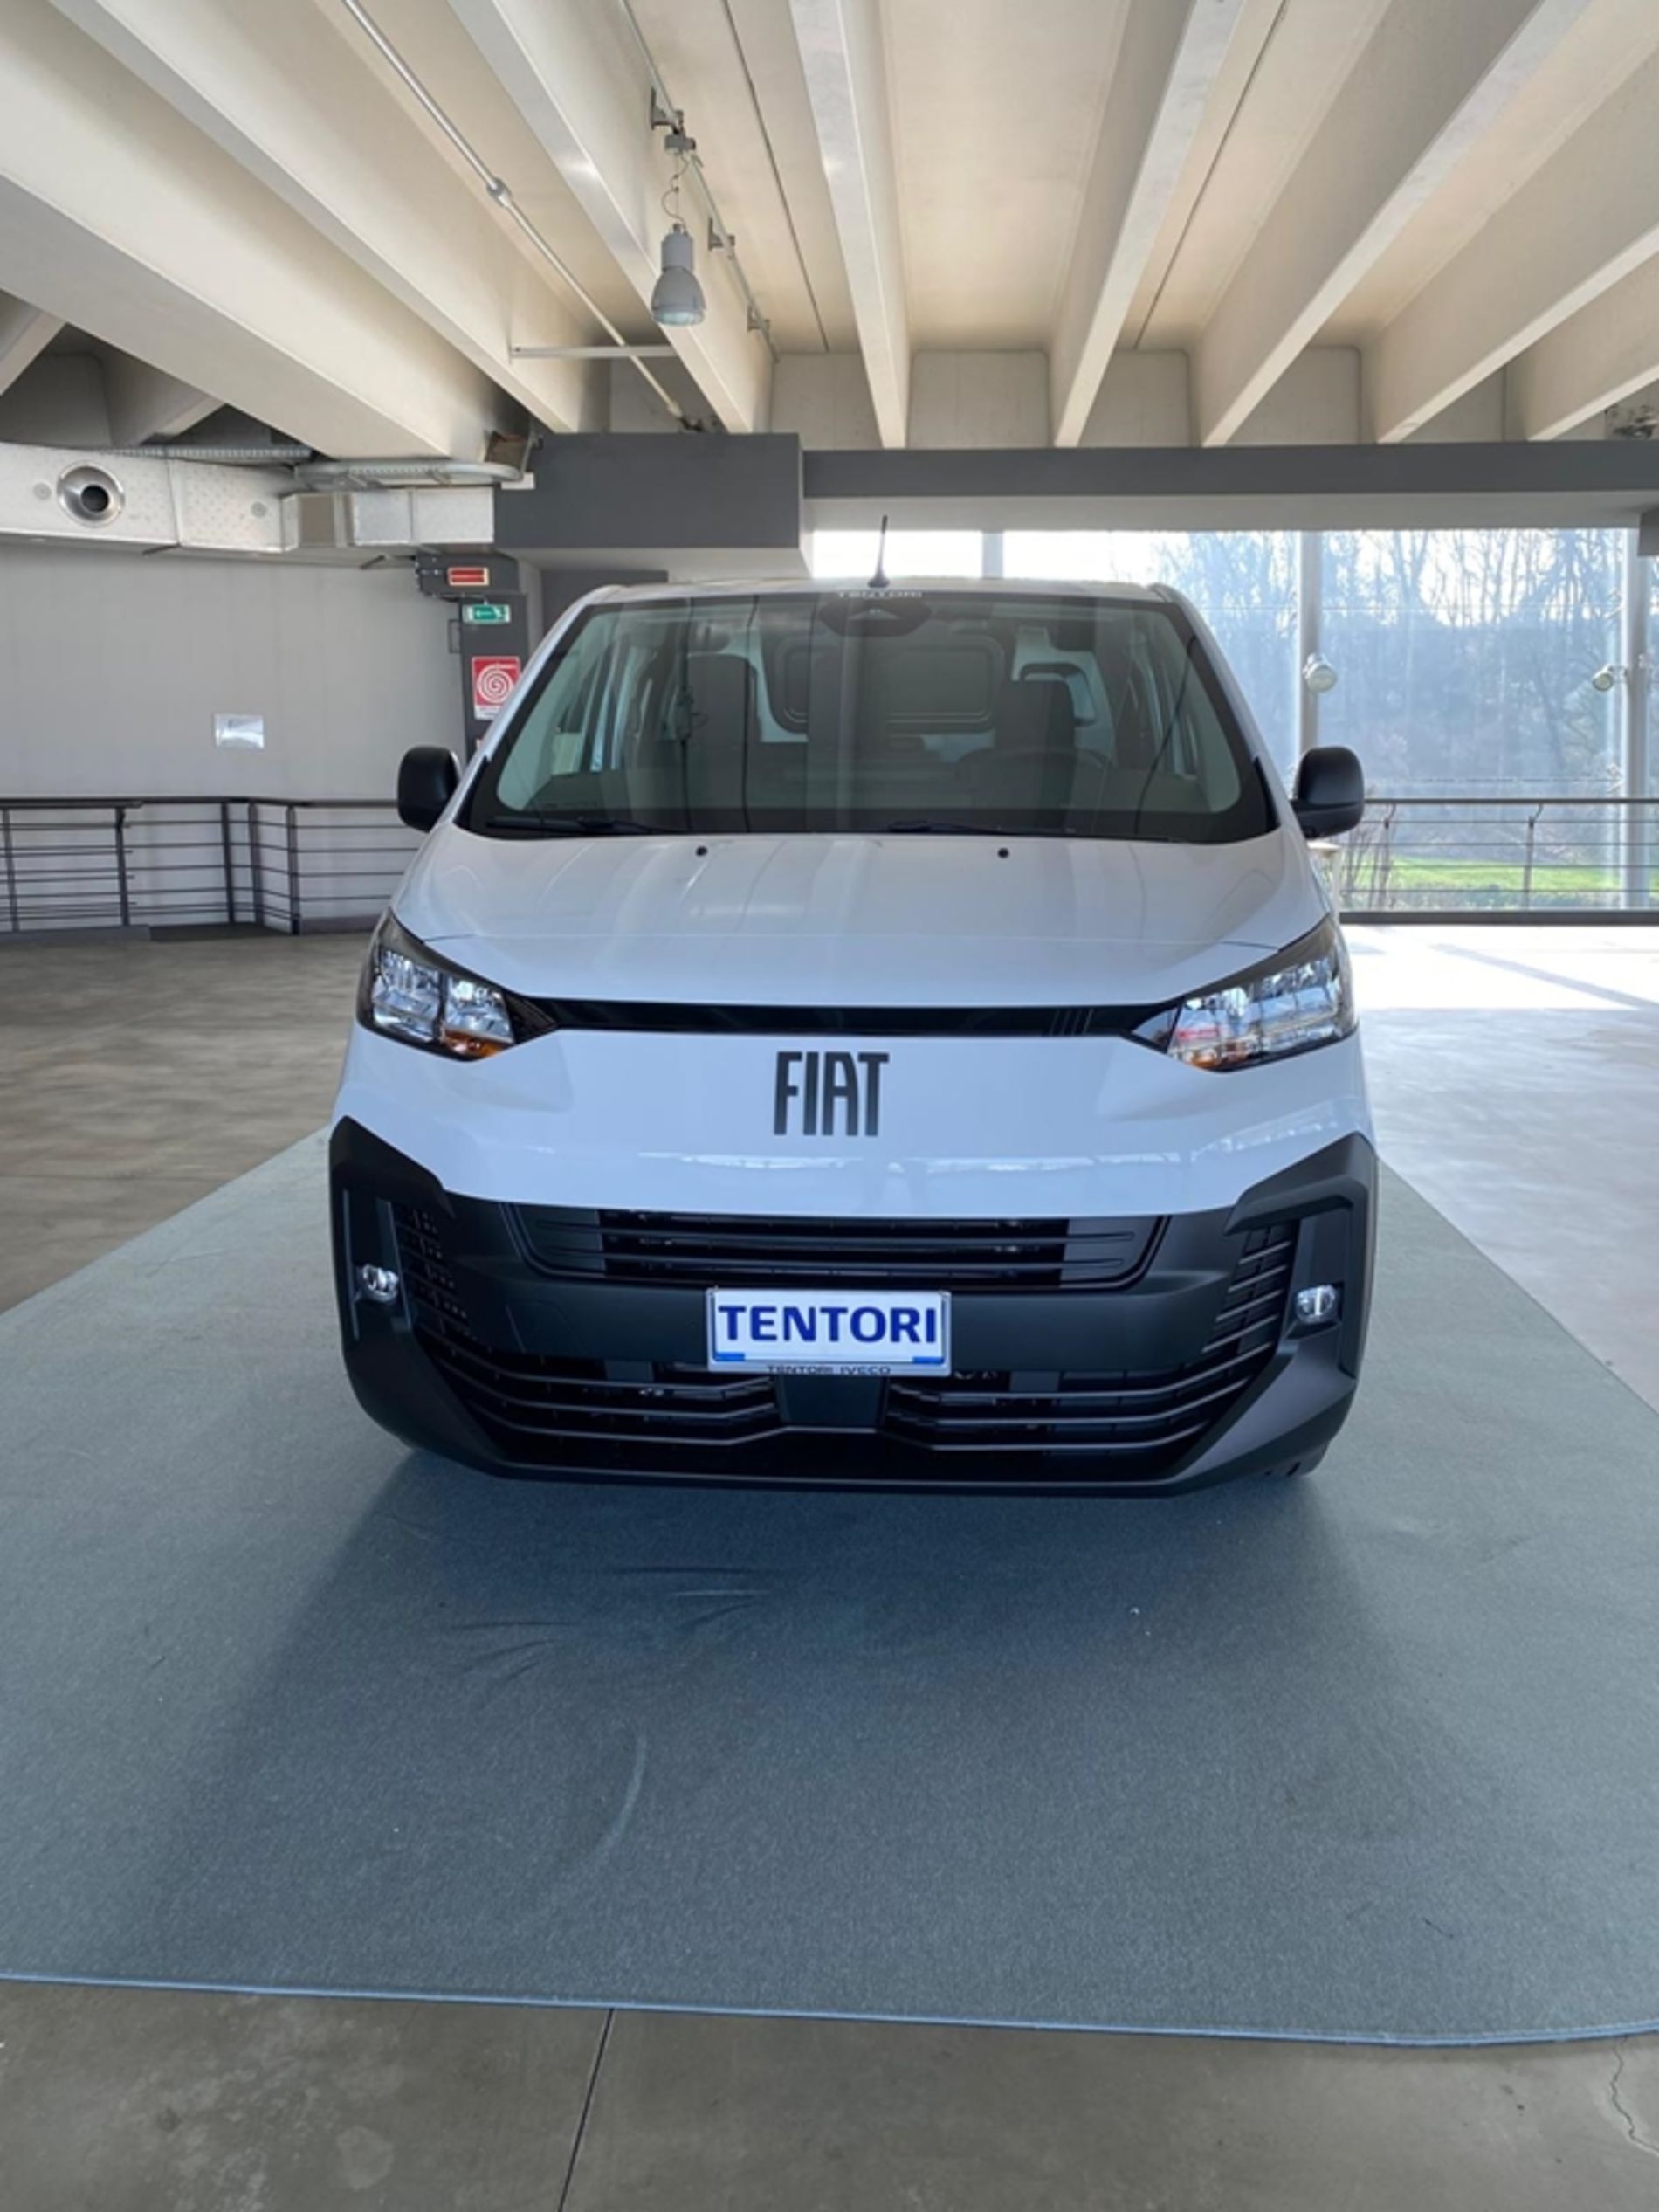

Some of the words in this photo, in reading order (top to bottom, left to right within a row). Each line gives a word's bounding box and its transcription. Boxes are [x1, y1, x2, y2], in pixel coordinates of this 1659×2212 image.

[774, 1051, 890, 1136] FIAT
[719, 1306, 937, 1343] TENTORI
[768, 1366, 834, 1375] TENTORI
[840, 1367, 891, 1375] IVECO
